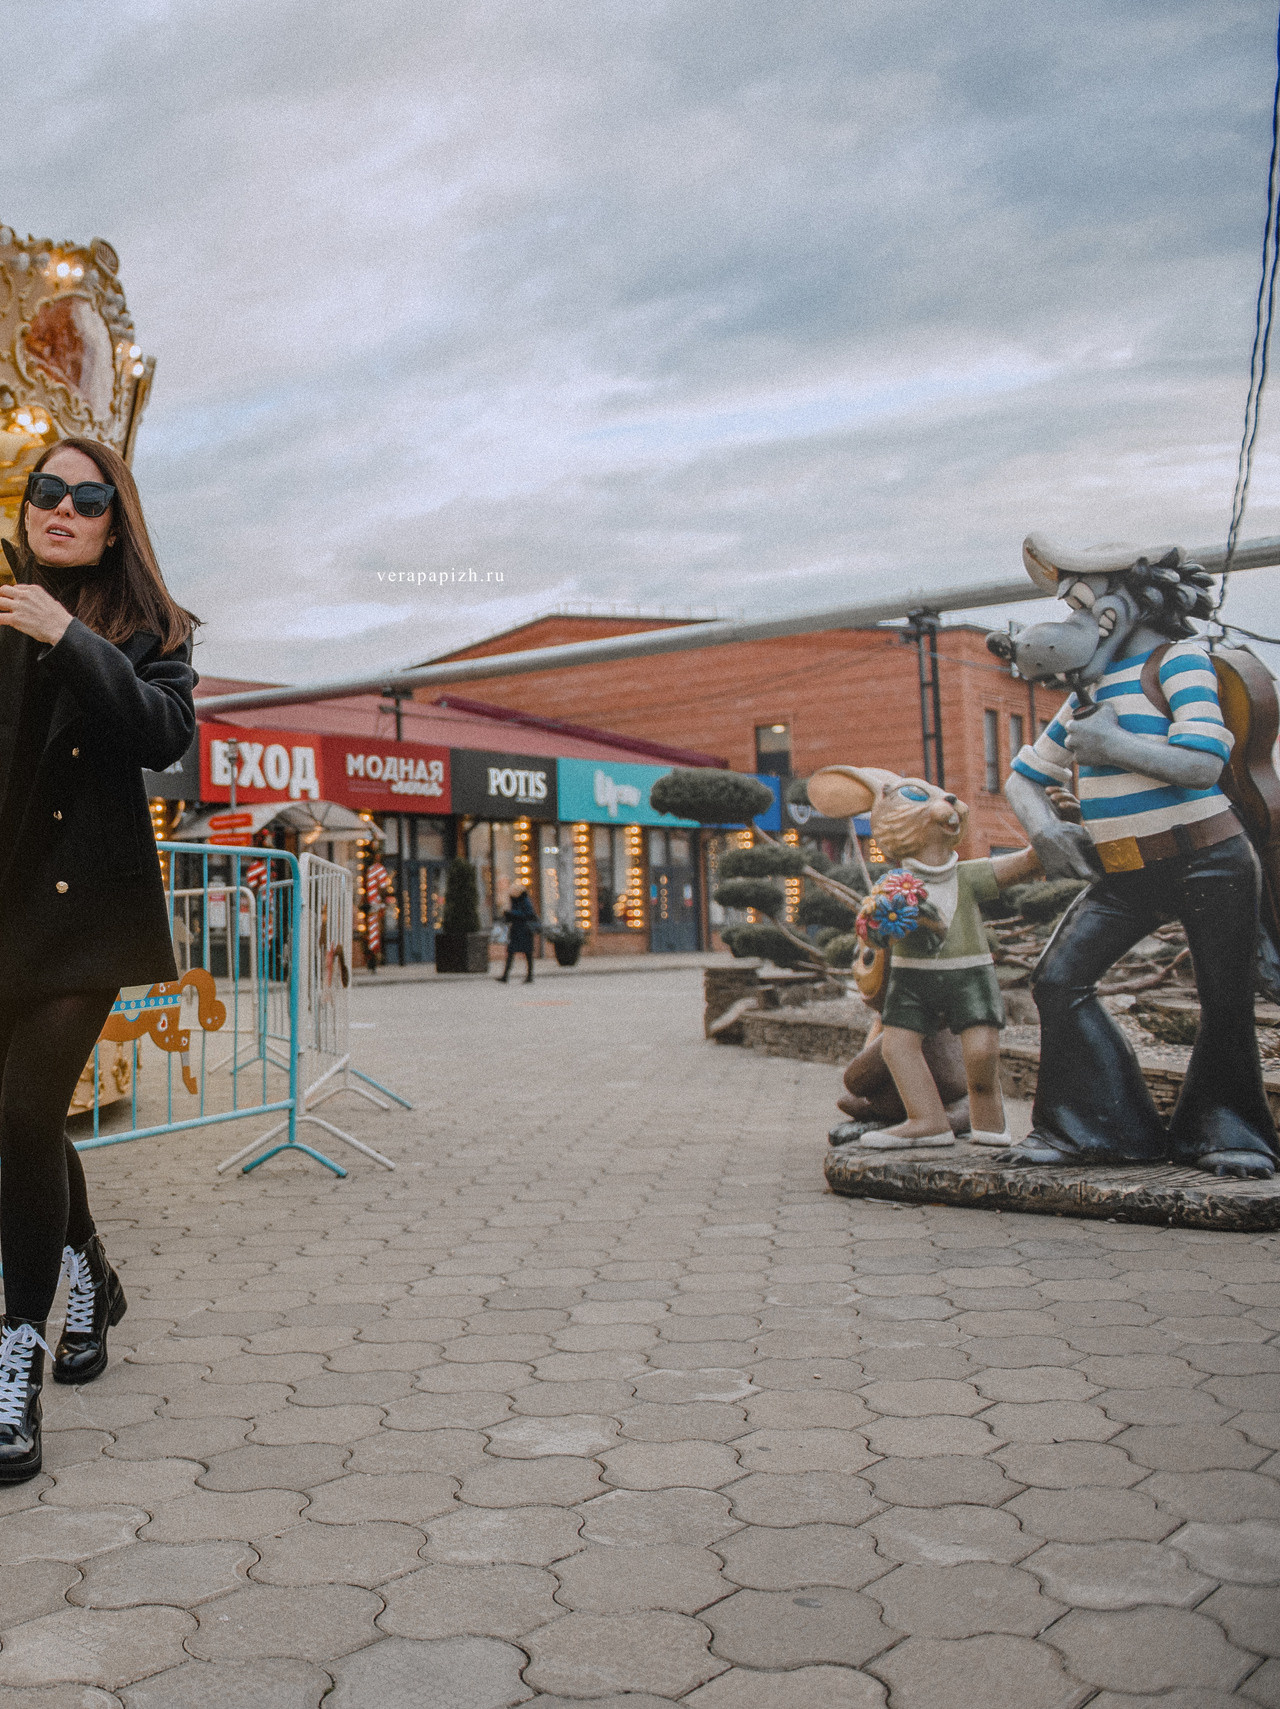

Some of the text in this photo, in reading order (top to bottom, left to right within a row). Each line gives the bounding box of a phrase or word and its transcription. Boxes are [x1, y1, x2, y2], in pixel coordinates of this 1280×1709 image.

[210, 739, 320, 800] ВХОД
[346, 753, 444, 783] МОДНАЯ
[487, 767, 548, 799] POTIS
